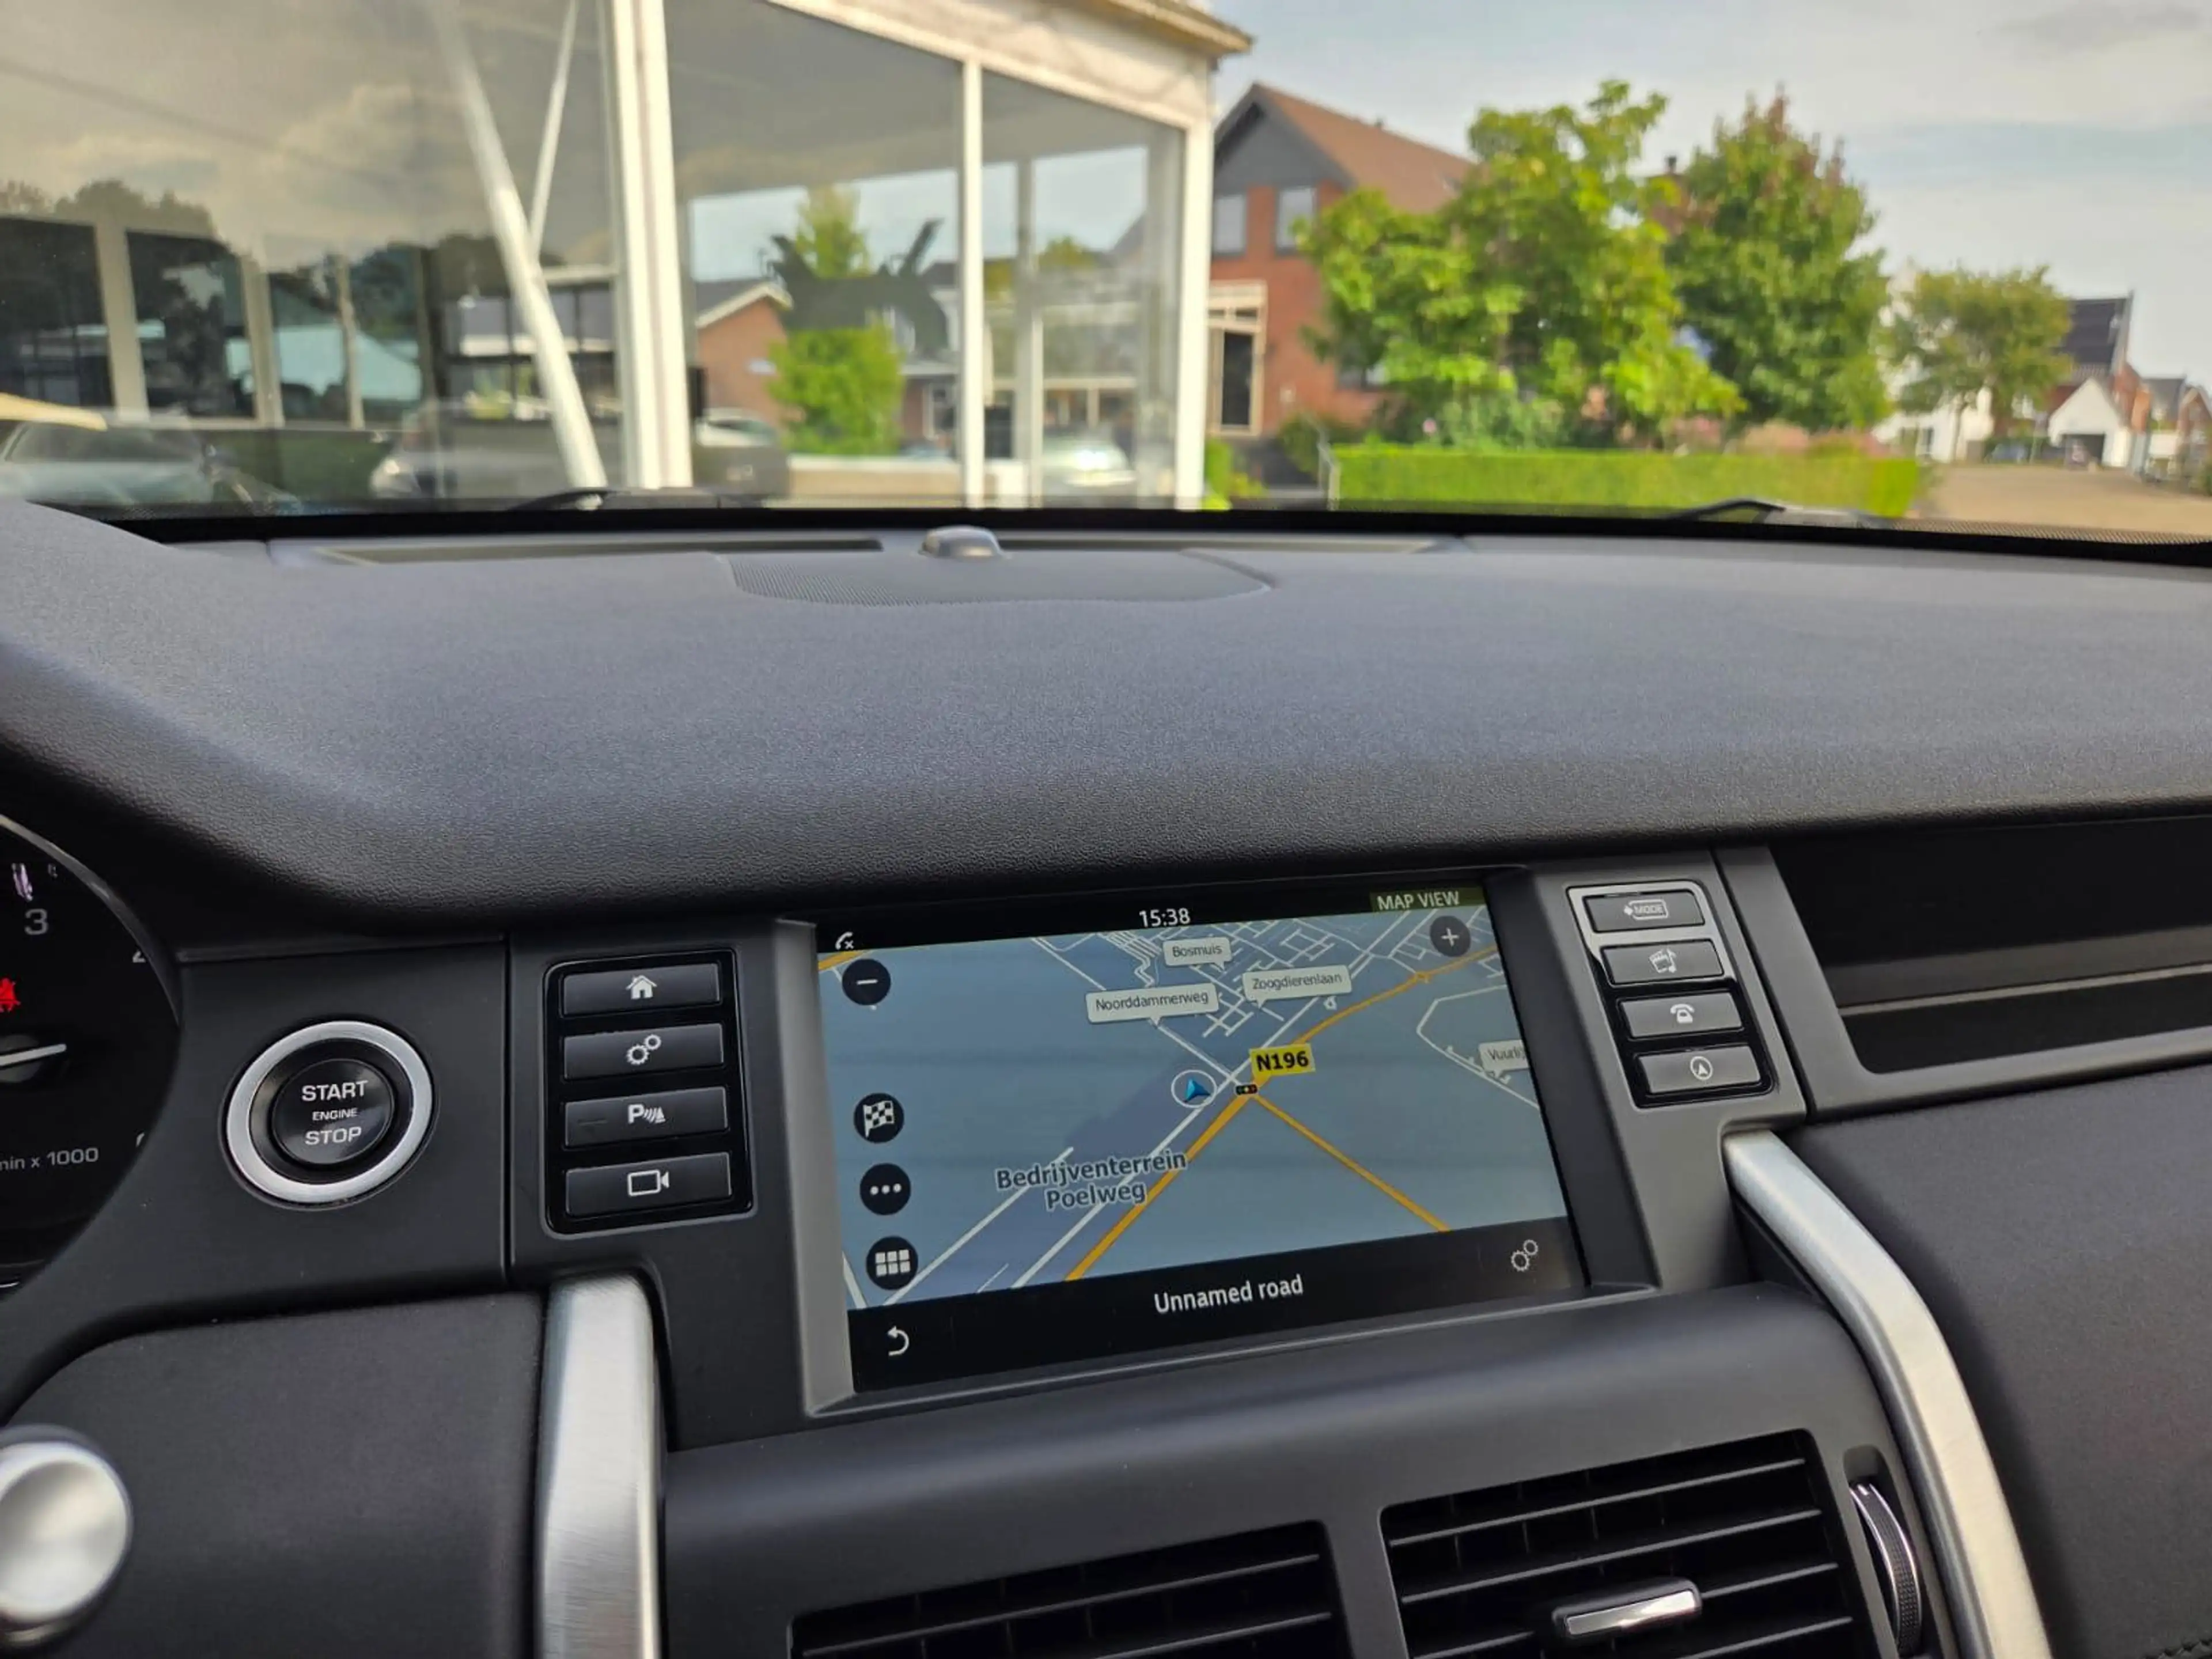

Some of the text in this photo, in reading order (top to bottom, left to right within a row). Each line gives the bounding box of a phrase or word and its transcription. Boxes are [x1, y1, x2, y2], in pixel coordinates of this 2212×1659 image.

[1377, 891, 1460, 911] MAP VIEW
[24, 908, 49, 935] 3
[1139, 907, 1191, 927] 15:38
[1172, 944, 1223, 958] Bosmuis
[1252, 972, 1342, 991] Zoogdierenlaan
[1096, 990, 1209, 1011] Noorddammerweg
[1256, 1050, 1309, 1072] N196
[301, 1080, 368, 1101] START
[312, 1107, 358, 1122] ENGINE
[305, 1126, 362, 1146] STOP
[47, 1147, 100, 1166] 1000
[997, 1151, 1187, 1190] Bedrijventerrein
[1046, 1182, 1146, 1209] Poelweg
[1154, 1273, 1304, 1314] Unnamed road
